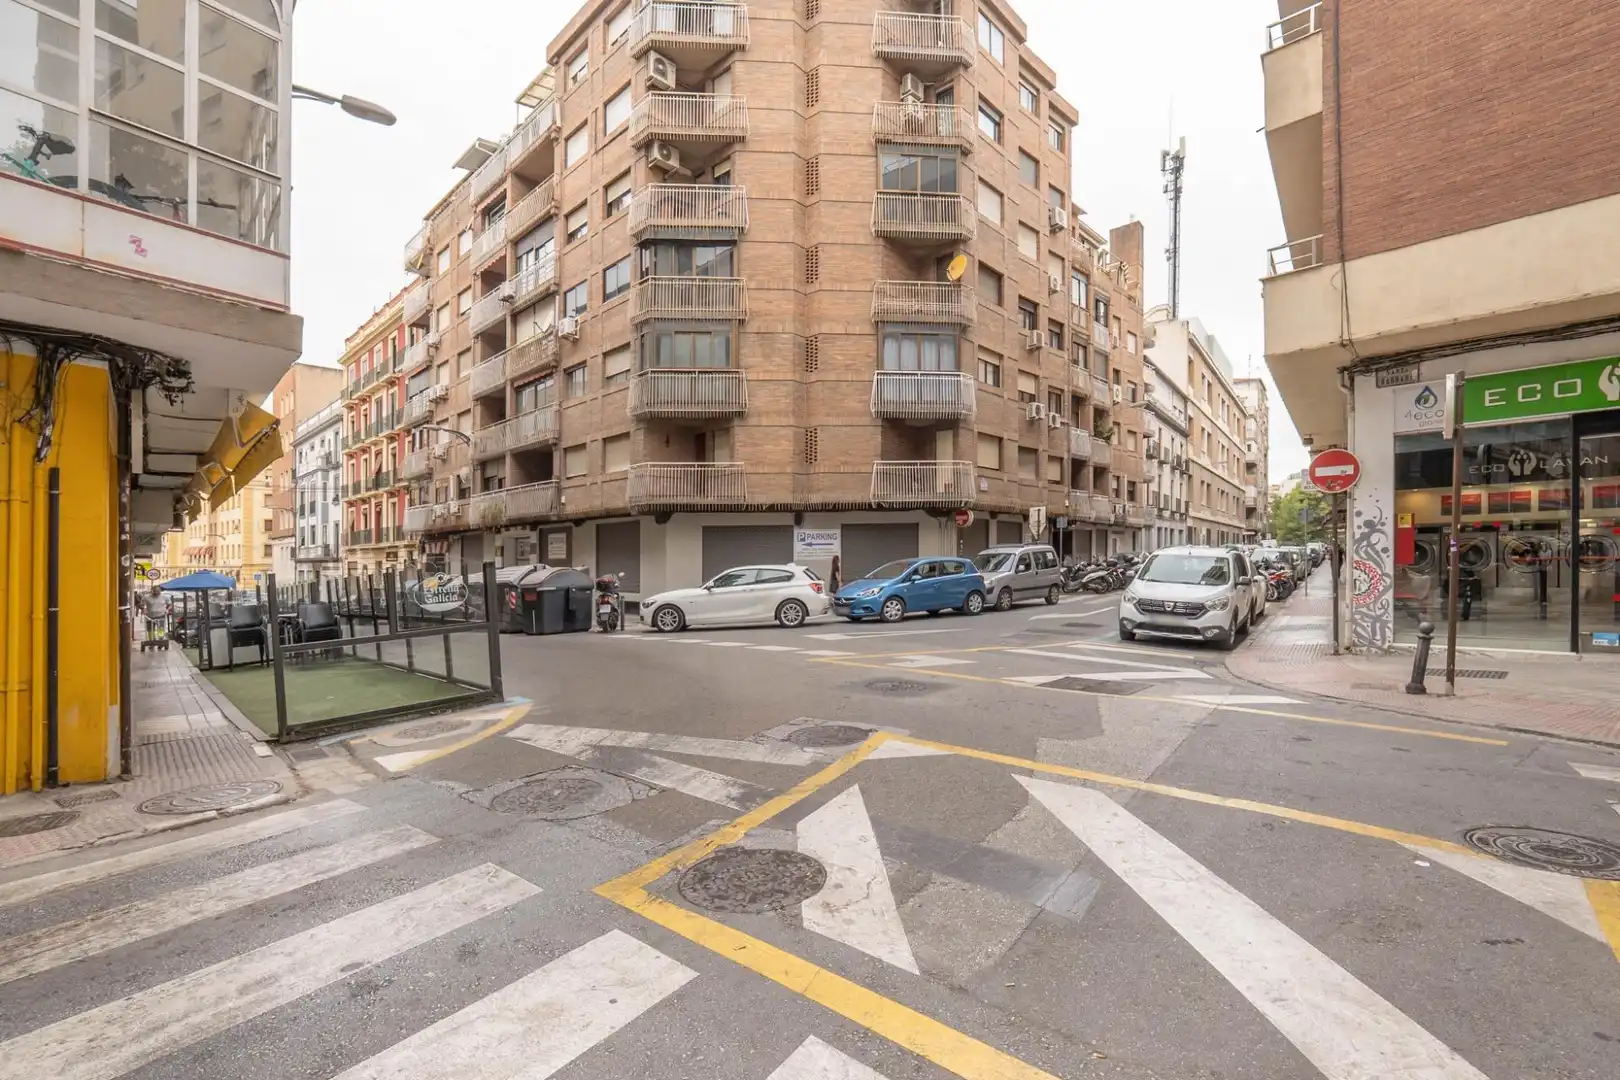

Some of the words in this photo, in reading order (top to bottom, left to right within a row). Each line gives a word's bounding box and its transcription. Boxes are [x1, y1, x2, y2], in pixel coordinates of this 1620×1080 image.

[1484, 378, 1582, 407] ECO
[1468, 463, 1505, 474] ECO
[806, 532, 838, 541] PARKING
[424, 592, 458, 604] Galicia
